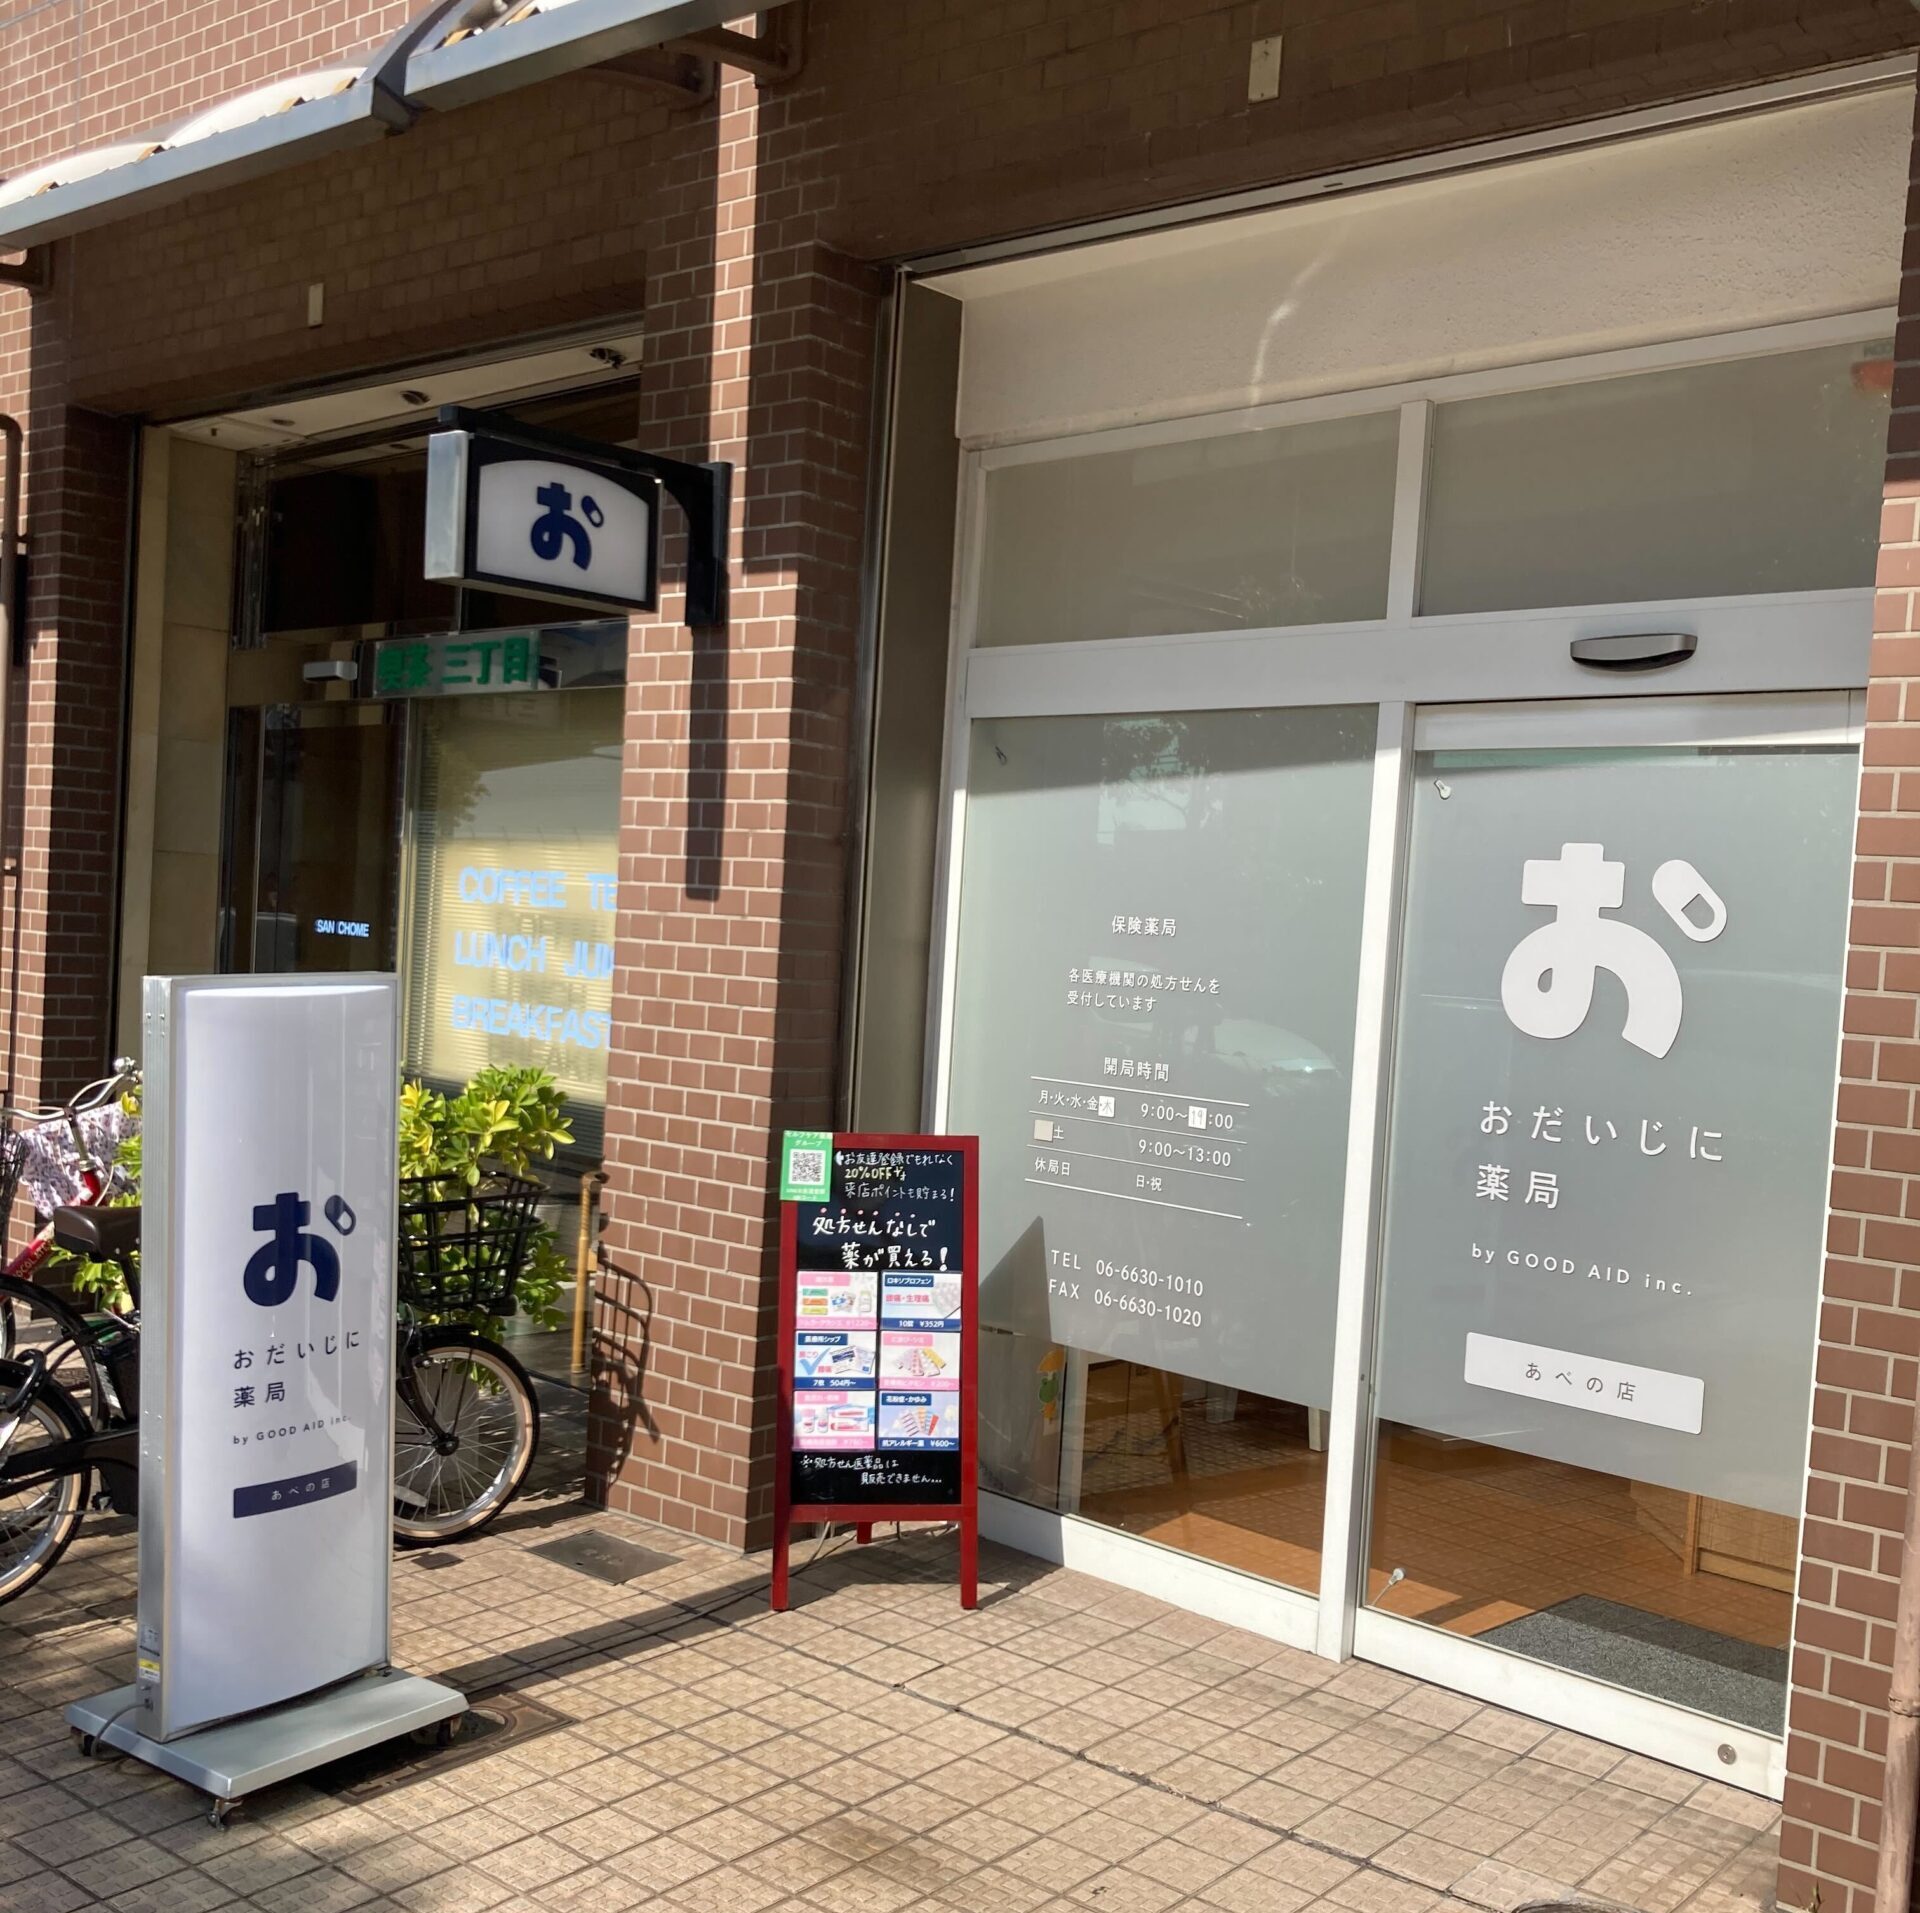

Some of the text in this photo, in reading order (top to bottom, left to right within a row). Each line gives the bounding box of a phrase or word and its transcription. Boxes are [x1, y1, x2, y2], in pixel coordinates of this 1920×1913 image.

[530, 482, 604, 571] お
[442, 636, 531, 685] 三丁目
[459, 866, 567, 908] COFFEE
[315, 919, 370, 937] SAN CHOME
[1111, 915, 1177, 938] 保険薬局
[454, 930, 547, 973] LUNCH
[1501, 842, 1728, 1059] お
[1068, 968, 1221, 995] 各医療機関の処方せんを
[1066, 991, 1157, 1012] 受付しています
[1103, 1057, 1170, 1082] 開局時間
[1053, 1125, 1231, 1167] 土 9:00〜13:00
[1480, 1101, 1722, 1162] おだいじに
[843, 1152, 953, 1166] お友達登録でもれなく
[1035, 1156, 1162, 1191] 休局日 日・祝
[1475, 1163, 1560, 1209] 薬局
[812, 1216, 936, 1238] 処方せんなしで
[243, 1192, 357, 1307] お
[841, 1242, 948, 1272] 薬が買える!
[1051, 1249, 1204, 1297] TEL 06-6630-1010
[1471, 1243, 1692, 1296] by GOOD AID inc.
[1048, 1278, 1202, 1327] FAX 06-6630-1020
[233, 1331, 360, 1370] おだいじに
[233, 1381, 285, 1408] 薬局
[1525, 1362, 1637, 1402] あべの店
[233, 1415, 351, 1445] by GOOD AID inc.
[271, 1477, 331, 1501] あべの店
